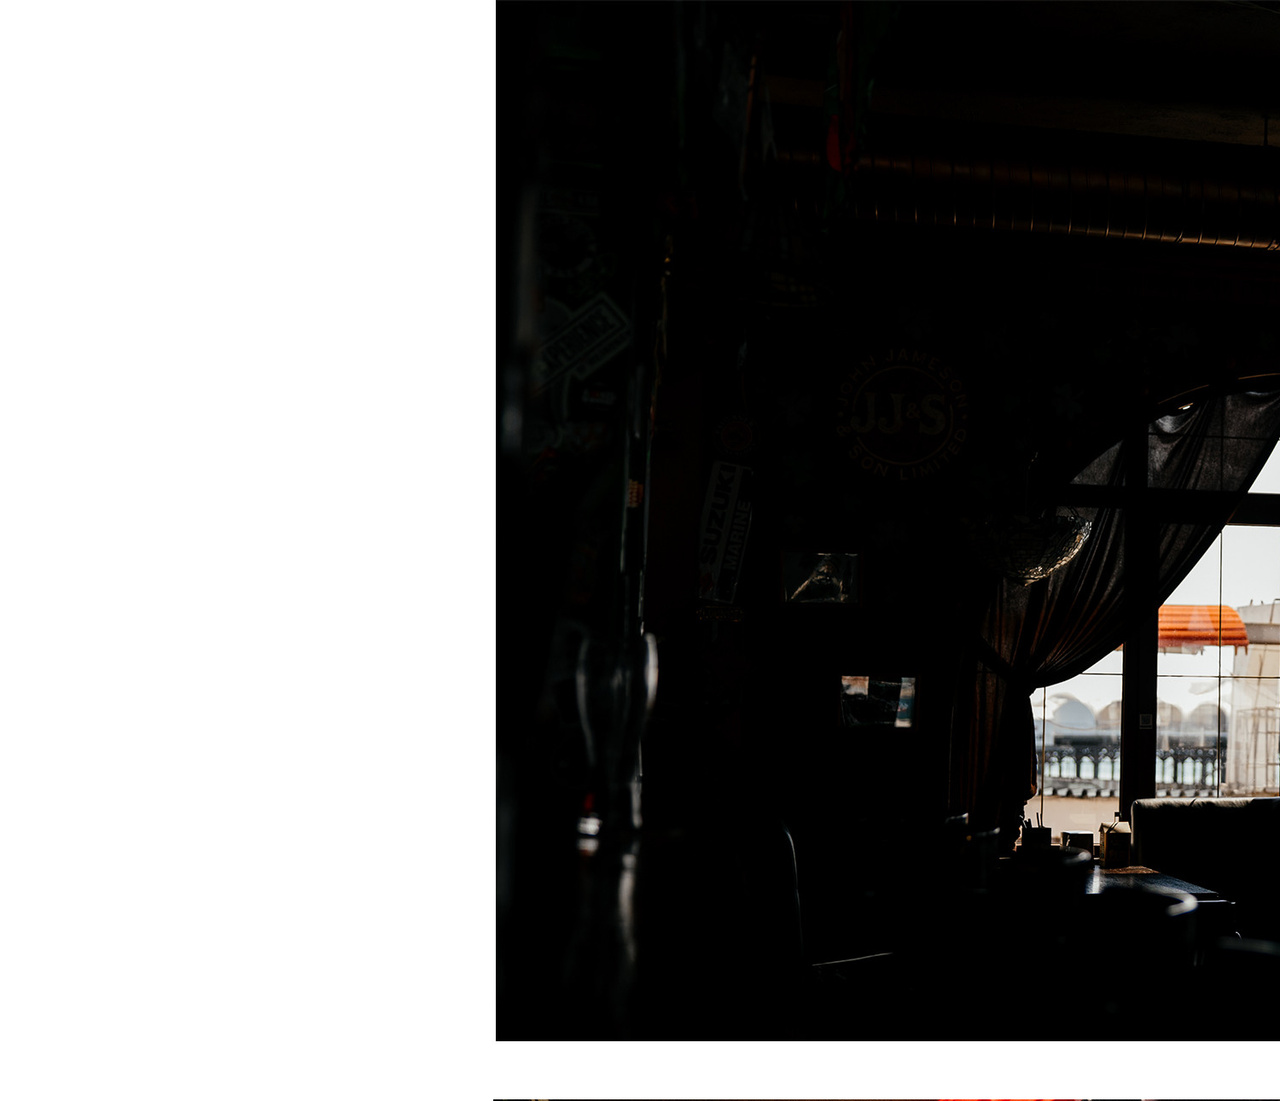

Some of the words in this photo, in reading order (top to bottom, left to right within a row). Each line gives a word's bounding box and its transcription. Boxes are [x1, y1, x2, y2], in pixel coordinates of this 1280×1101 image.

[836, 353, 877, 407] JOHN
[884, 347, 969, 409] JAMESON
[849, 391, 947, 436] JJ&S
[848, 443, 889, 478] SON
[899, 427, 969, 481] LIMITED
[700, 464, 737, 565] SUZUKI
[723, 498, 752, 572] MARINE
